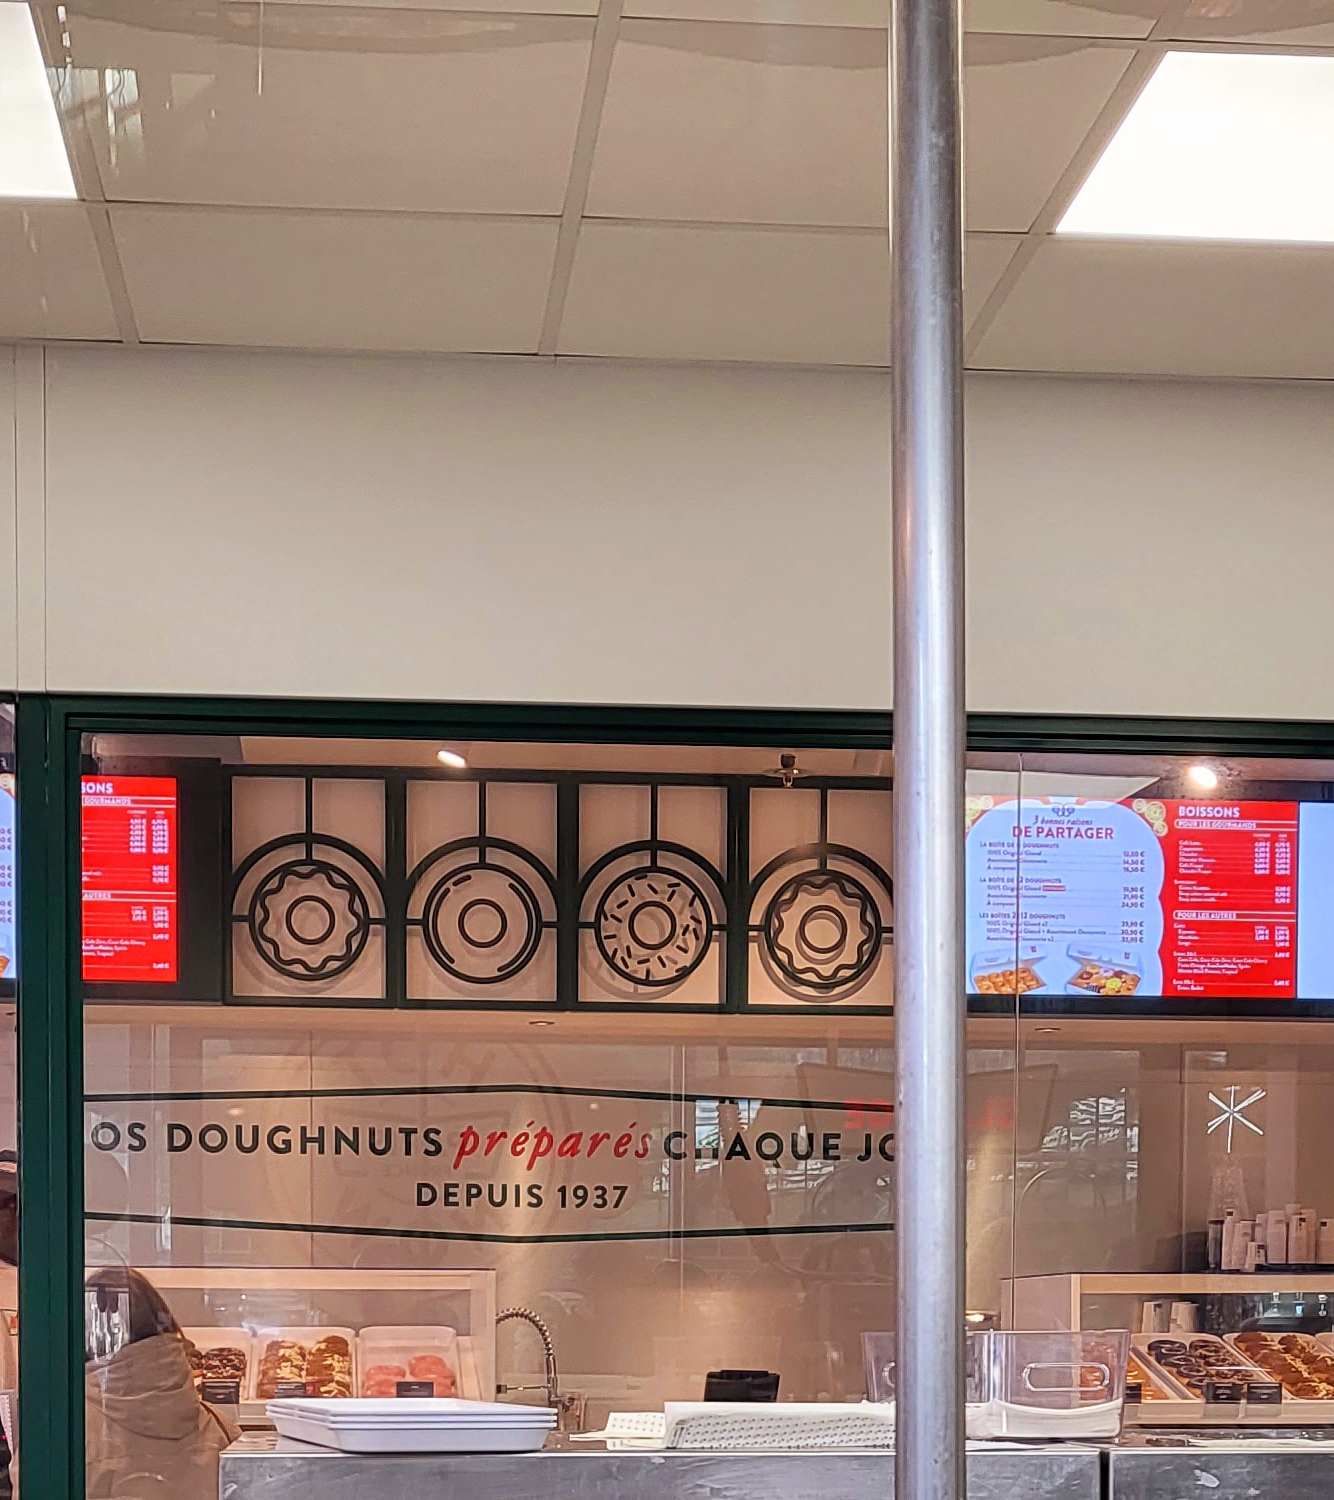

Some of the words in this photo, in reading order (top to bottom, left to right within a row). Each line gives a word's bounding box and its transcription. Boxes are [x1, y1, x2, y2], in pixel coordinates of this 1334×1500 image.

[1178, 806, 1240, 818] BOISSONS
[1012, 826, 1032, 838] DE
[1036, 826, 1114, 840] PARTAGER
[91, 1121, 147, 1152] OS
[167, 1123, 442, 1157] DOUGHNUTS
[453, 1120, 653, 1170] préparés
[663, 1131, 841, 1168] CHAQUE
[857, 1133, 895, 1162] JO
[417, 1182, 543, 1209] DEPUIS
[556, 1185, 628, 1209] 1937
